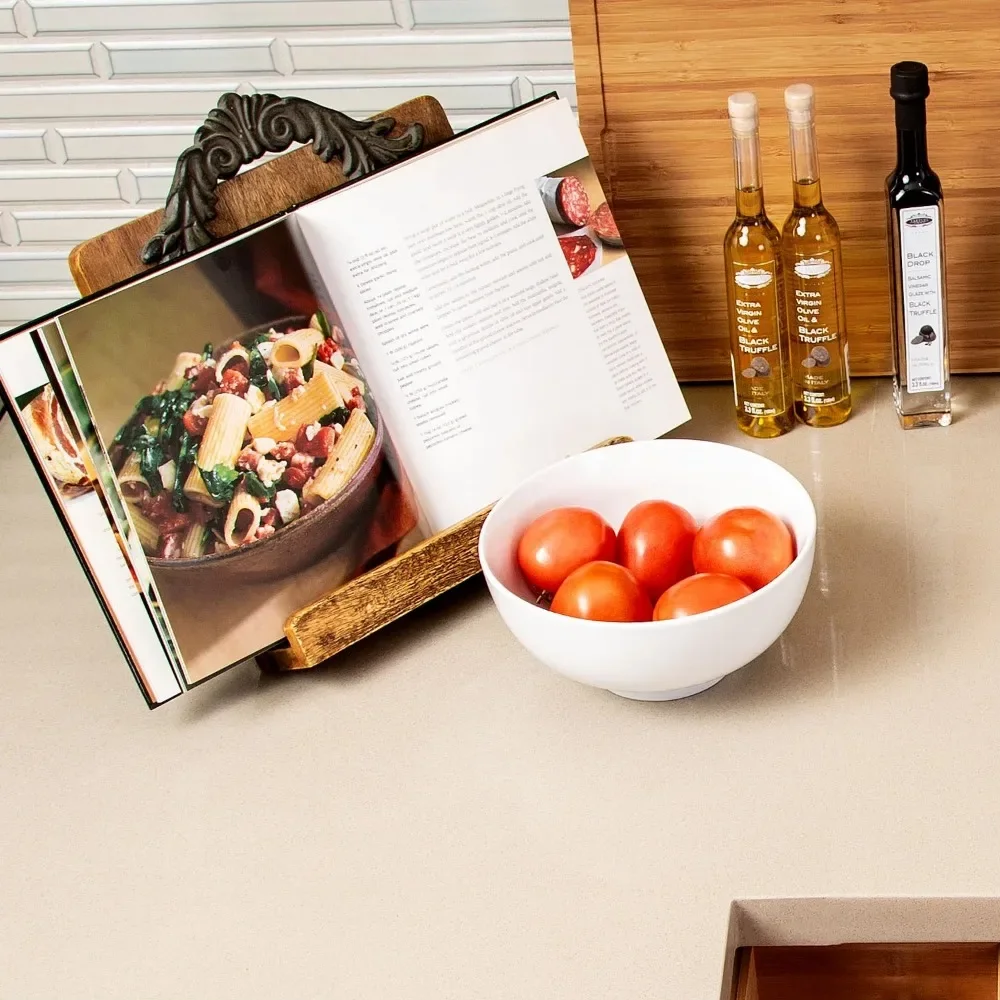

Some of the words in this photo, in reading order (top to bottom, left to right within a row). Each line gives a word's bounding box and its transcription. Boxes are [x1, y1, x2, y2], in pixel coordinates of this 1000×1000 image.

[907, 252, 934, 260] BLACK
[736, 300, 761, 308] EXTRA
[796, 307, 820, 315] OLIVE
[737, 317, 759, 325] OLIVE
[798, 326, 829, 335] BLACK
[739, 336, 769, 345] BLACK
[799, 332, 838, 343] TRUFFLE
[739, 343, 778, 354] TRUFFLE
